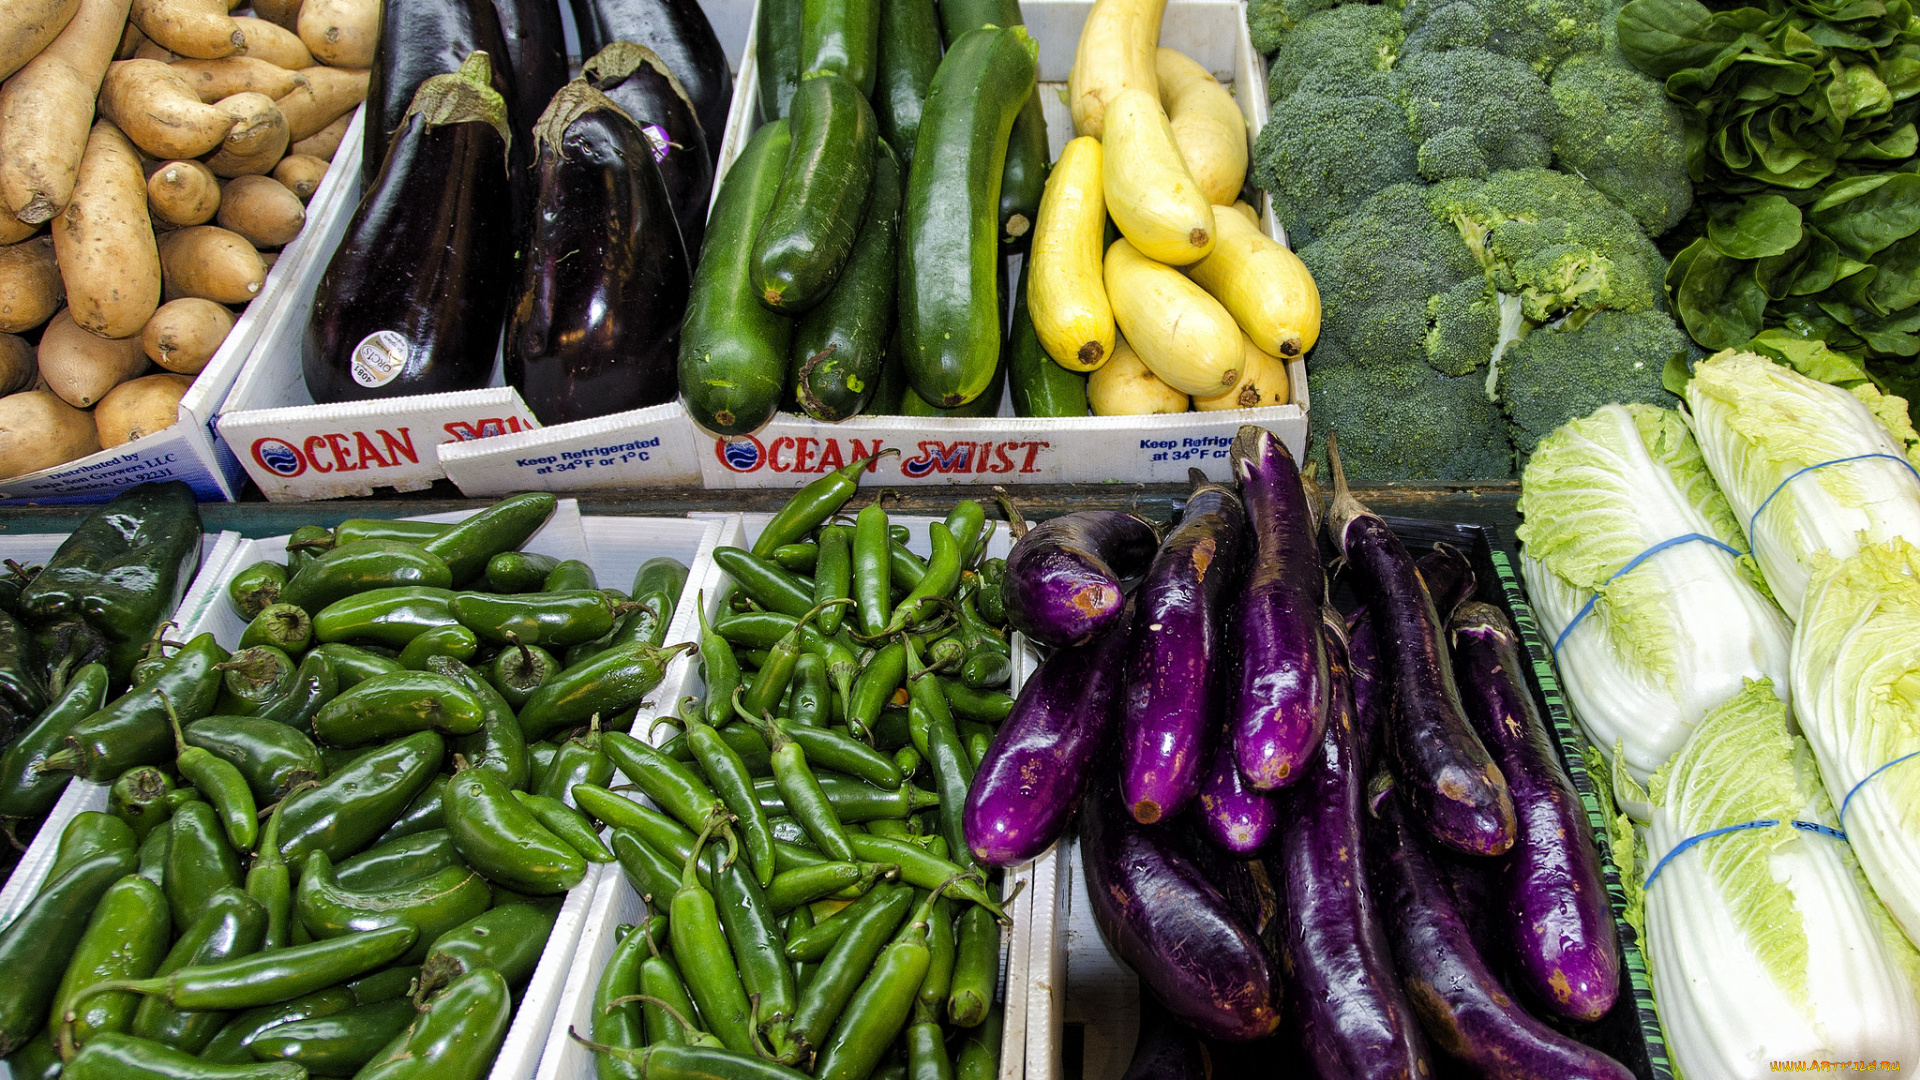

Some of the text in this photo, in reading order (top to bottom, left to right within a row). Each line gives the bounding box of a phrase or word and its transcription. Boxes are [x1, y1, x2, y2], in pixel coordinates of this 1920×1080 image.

[354, 365, 372, 383] 4081
[251, 427, 420, 478] OCEAN
[442, 416, 534, 444] MI
[516, 436, 660, 467] Keep Refrigerated
[715, 433, 884, 473] OCEAN
[1140, 436, 1235, 449] Keep Refrig
[47, 453, 139, 480] Distributed by
[89, 464, 146, 480] Growers
[145, 453, 177, 468] LLC
[536, 465, 553, 475] at
[599, 457, 615, 467] or
[1152, 452, 1168, 461] at
[1212, 450, 1230, 458] or
[113, 475, 136, 486] CA
[137, 468, 173, 481] 92231
